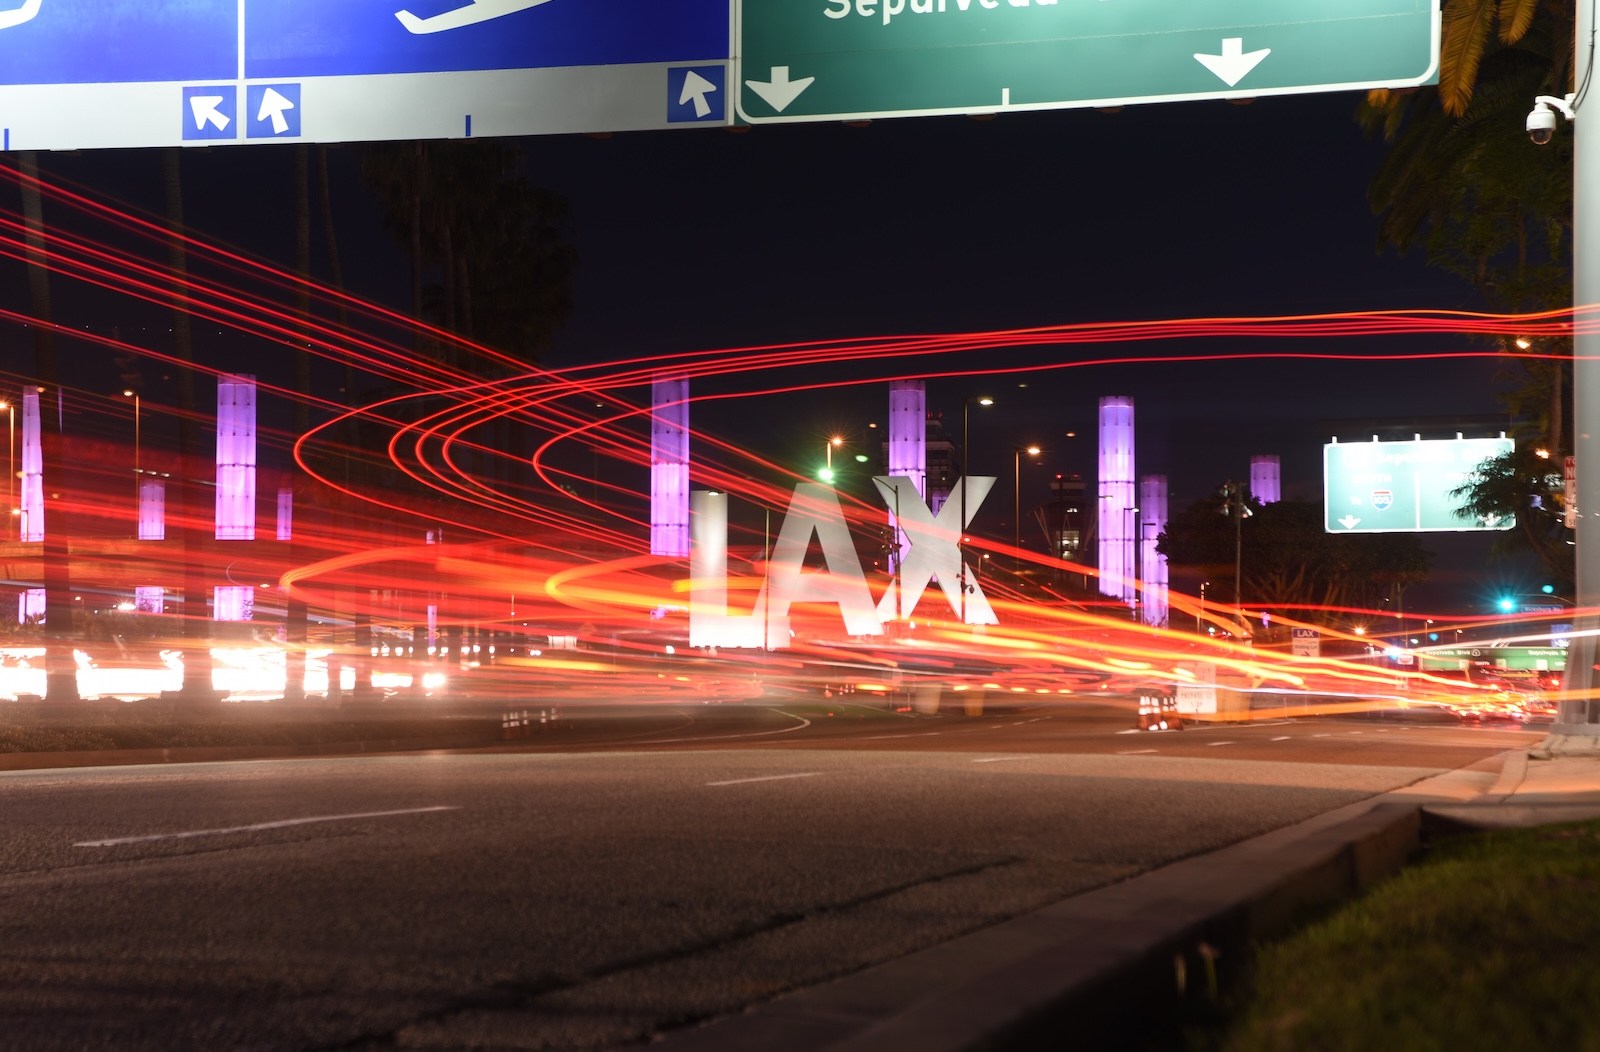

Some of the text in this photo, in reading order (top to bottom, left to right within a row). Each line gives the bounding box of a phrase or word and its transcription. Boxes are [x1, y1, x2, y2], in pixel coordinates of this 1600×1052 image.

[823, 0, 1058, 25] Sepuv
[689, 476, 1000, 648] LAX
[1297, 629, 1314, 638] LAX
